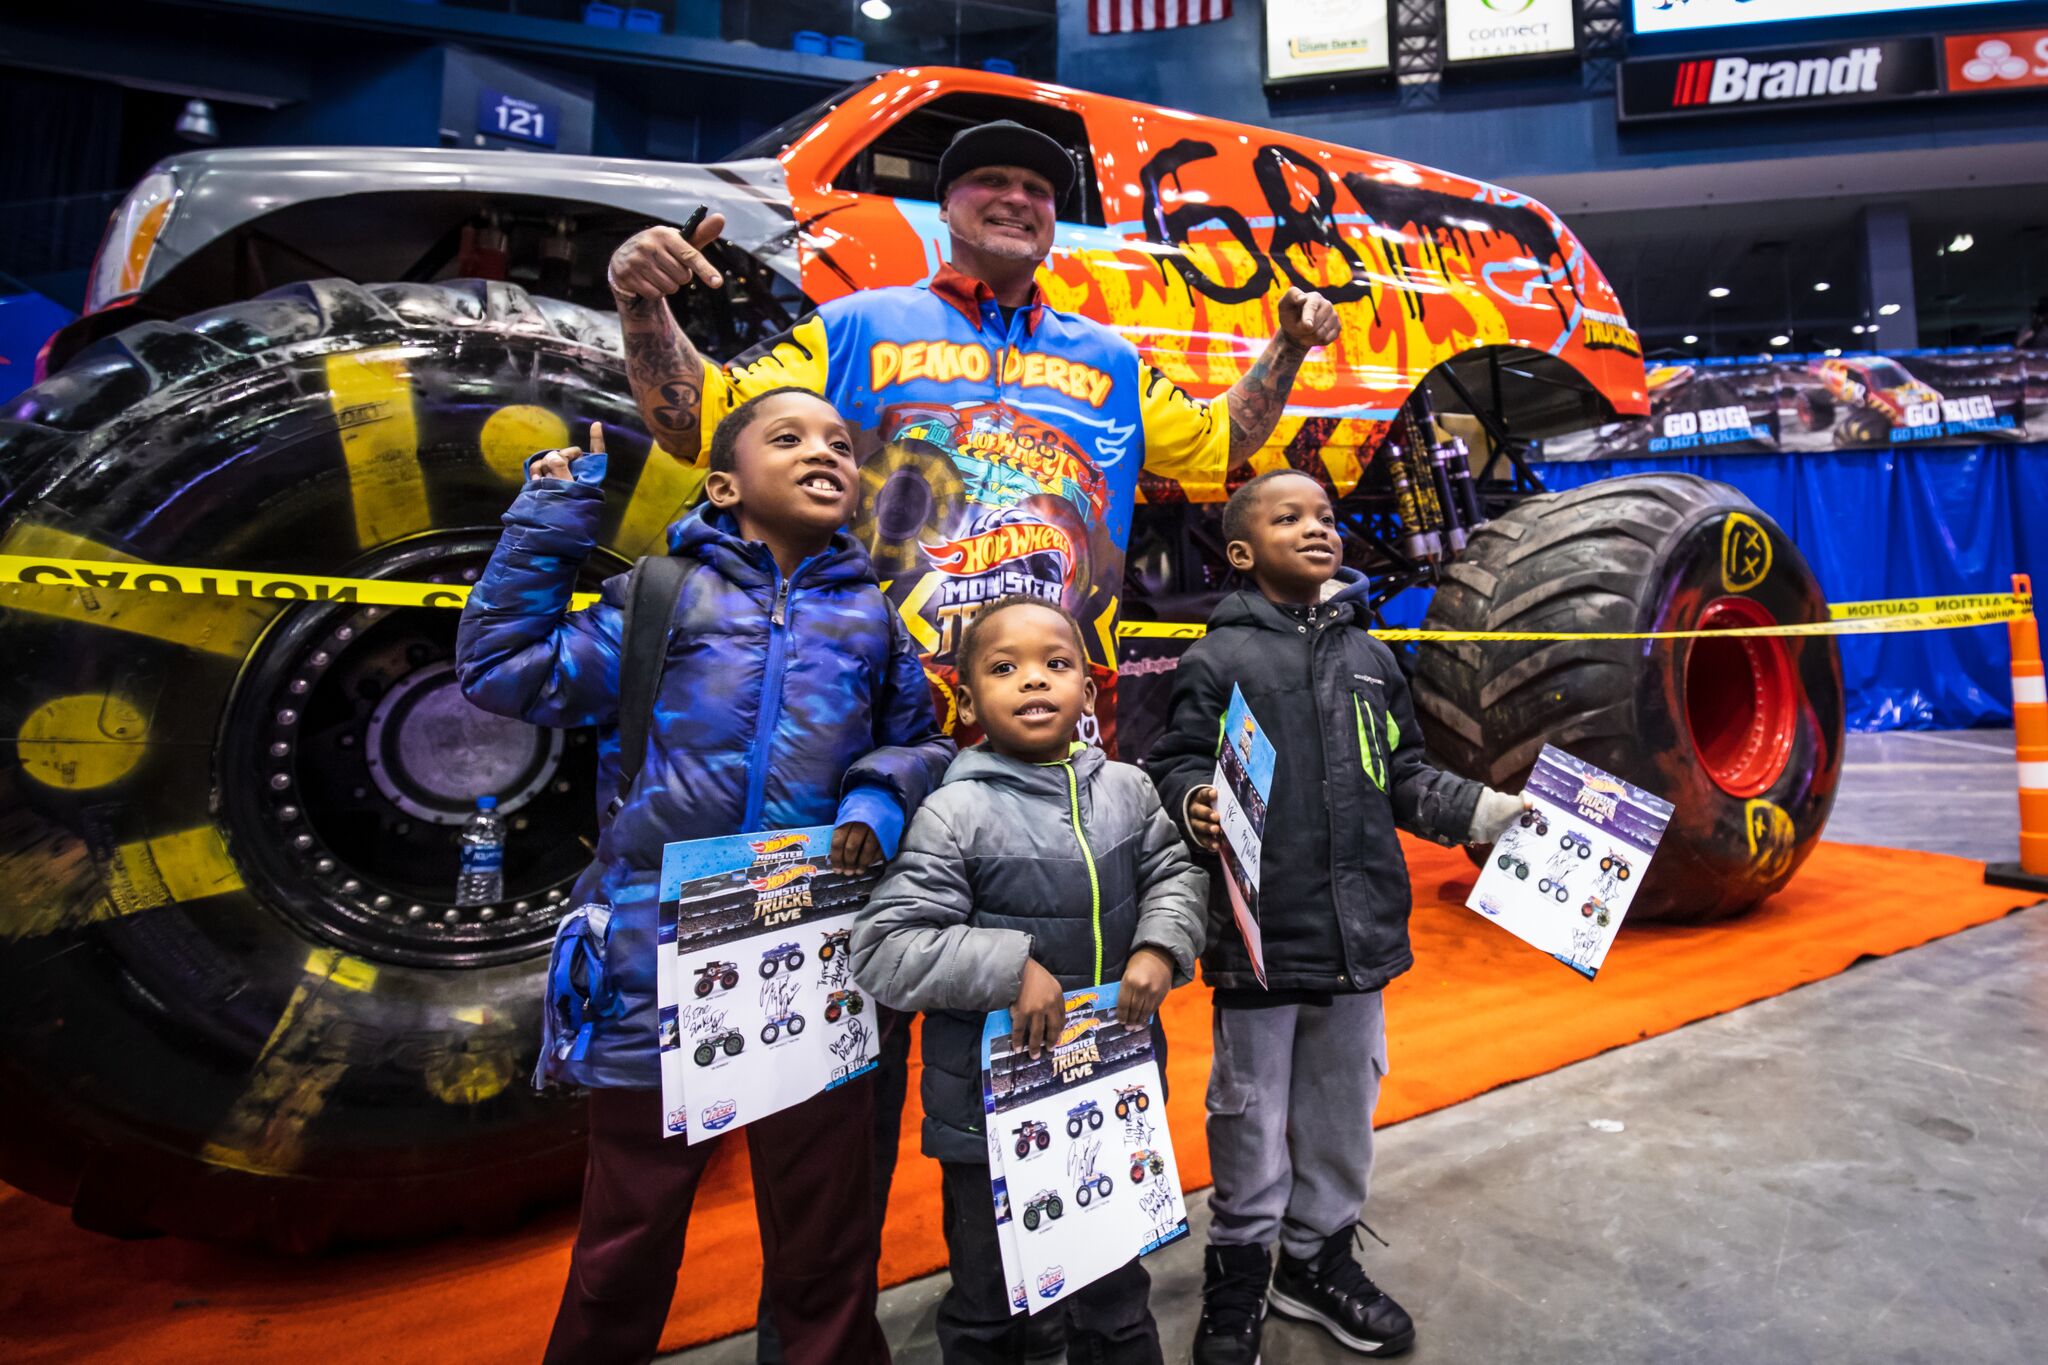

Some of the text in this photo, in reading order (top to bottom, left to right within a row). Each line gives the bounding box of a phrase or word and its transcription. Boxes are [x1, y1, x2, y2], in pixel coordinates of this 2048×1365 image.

[1709, 47, 1882, 104] Brandt
[494, 105, 544, 139] 121
[1139, 138, 1374, 306] 68
[870, 340, 1113, 408] DEMO DERBY
[1663, 405, 1751, 438] GO BIG!
[1906, 394, 1995, 428] GO BIG!
[943, 571, 1063, 606] MONSTER
[1577, 804, 1605, 825] LIVE
[756, 850, 804, 861] MONSTER
[753, 890, 814, 921] TRUCKS
[757, 883, 811, 901] MONSTER
[764, 907, 802, 927] LIVE
[1052, 1045, 1102, 1078] TRUCKS
[1053, 1037, 1096, 1057] MONSTER
[1062, 1063, 1094, 1084] LIVE
